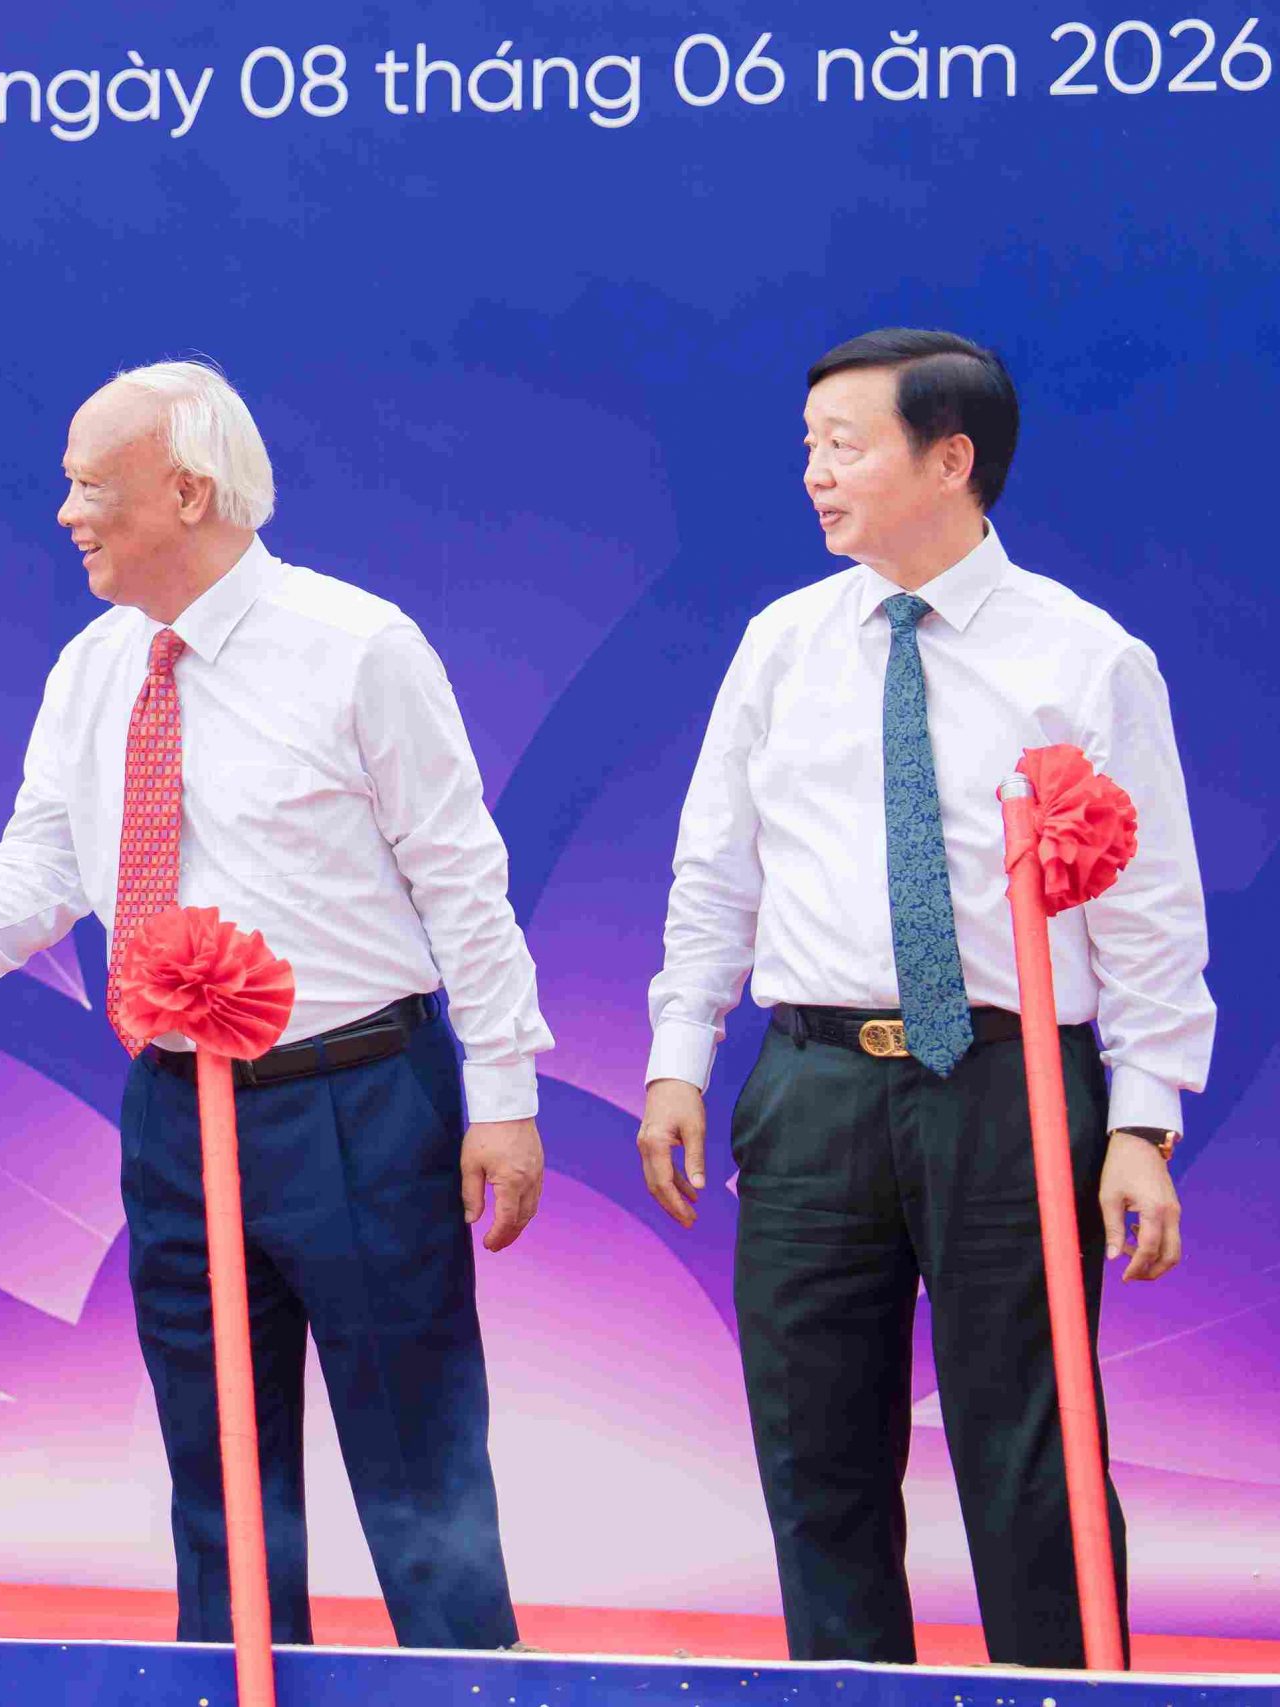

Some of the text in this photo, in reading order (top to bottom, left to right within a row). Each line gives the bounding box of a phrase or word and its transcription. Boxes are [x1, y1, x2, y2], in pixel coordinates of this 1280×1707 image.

[240, 44, 348, 119] 08
[375, 40, 640, 128] tháng
[674, 32, 785, 106] 06
[817, 30, 1016, 102] năm
[1049, 17, 1272, 96] 2026
